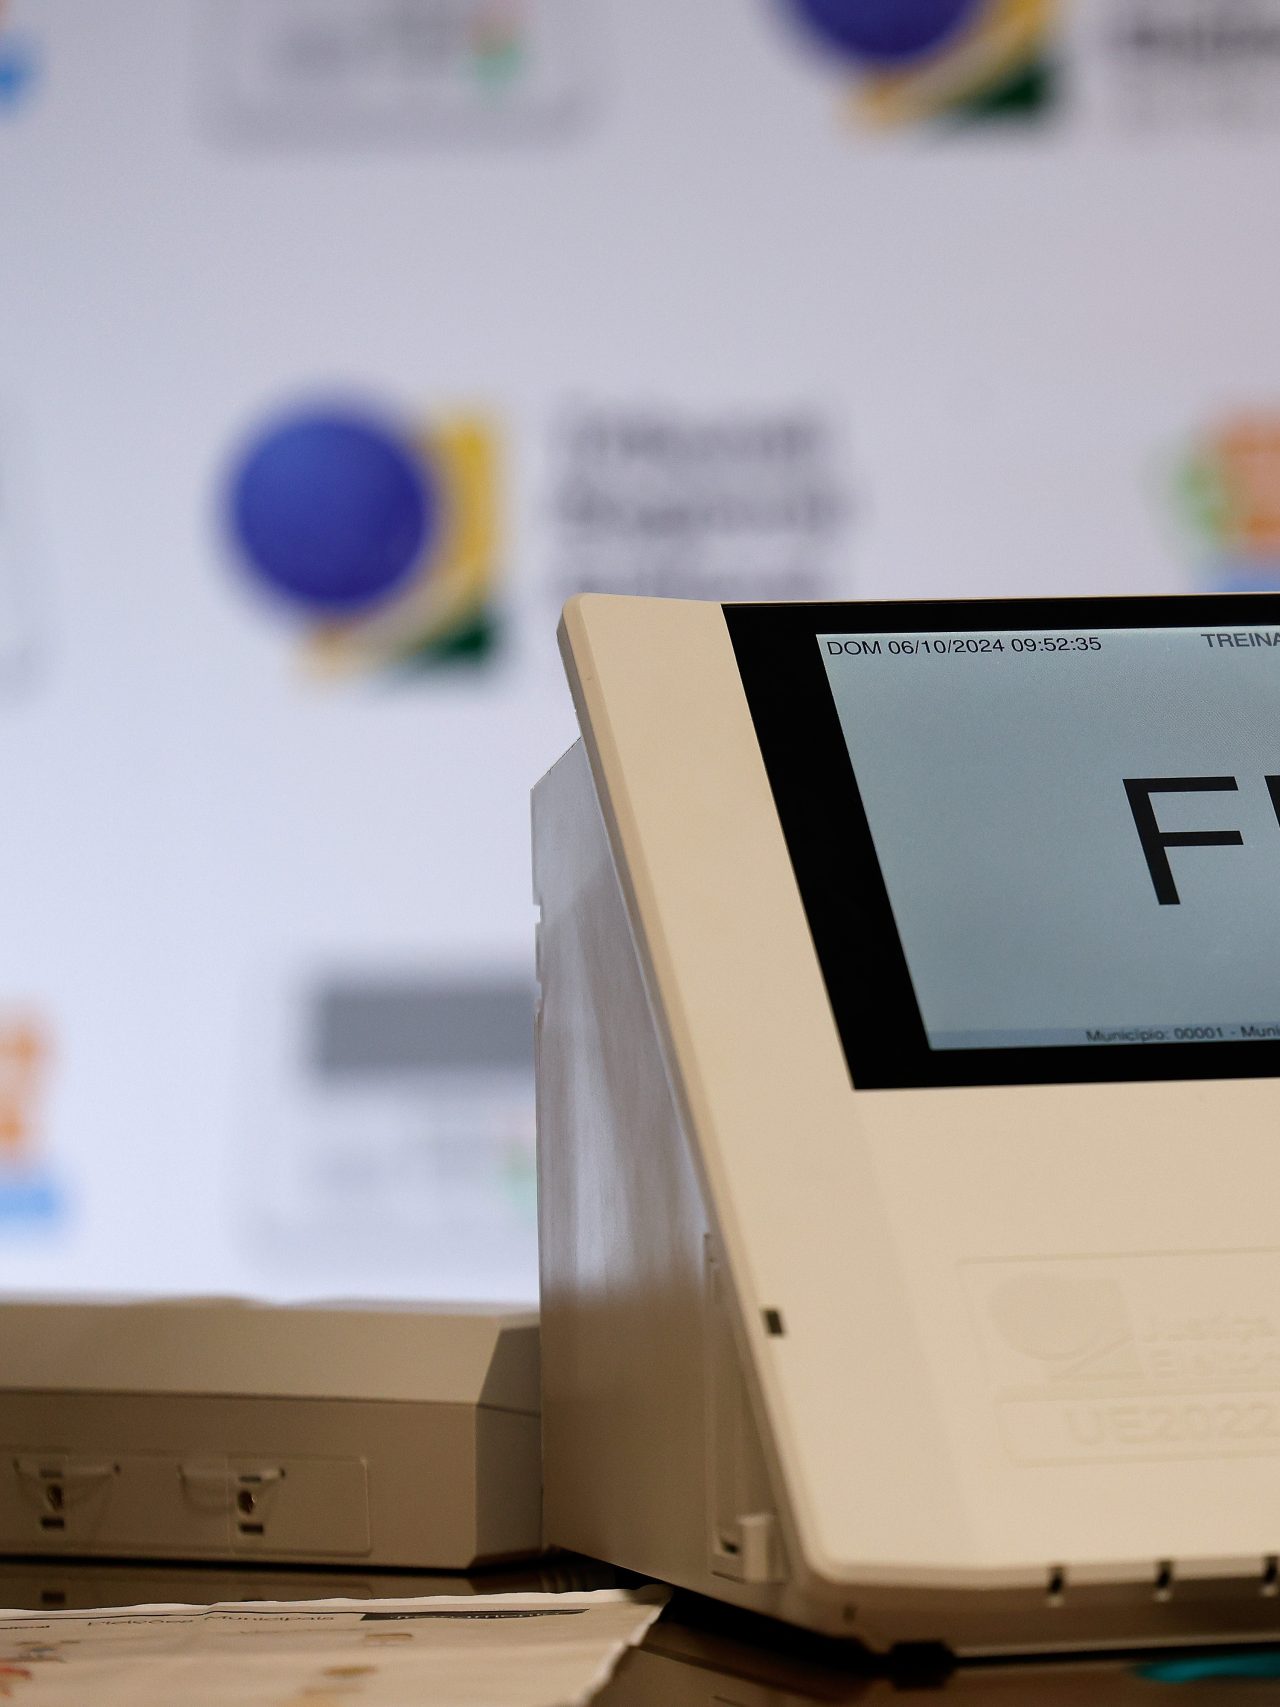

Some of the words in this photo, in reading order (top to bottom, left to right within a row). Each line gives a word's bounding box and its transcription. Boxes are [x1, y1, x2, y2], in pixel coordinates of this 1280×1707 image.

[826, 640, 882, 656] DOM
[888, 638, 1005, 655] 06/10/2024
[1011, 636, 1102, 653] 09:52:35
[1173, 1026, 1224, 1041] 00001
